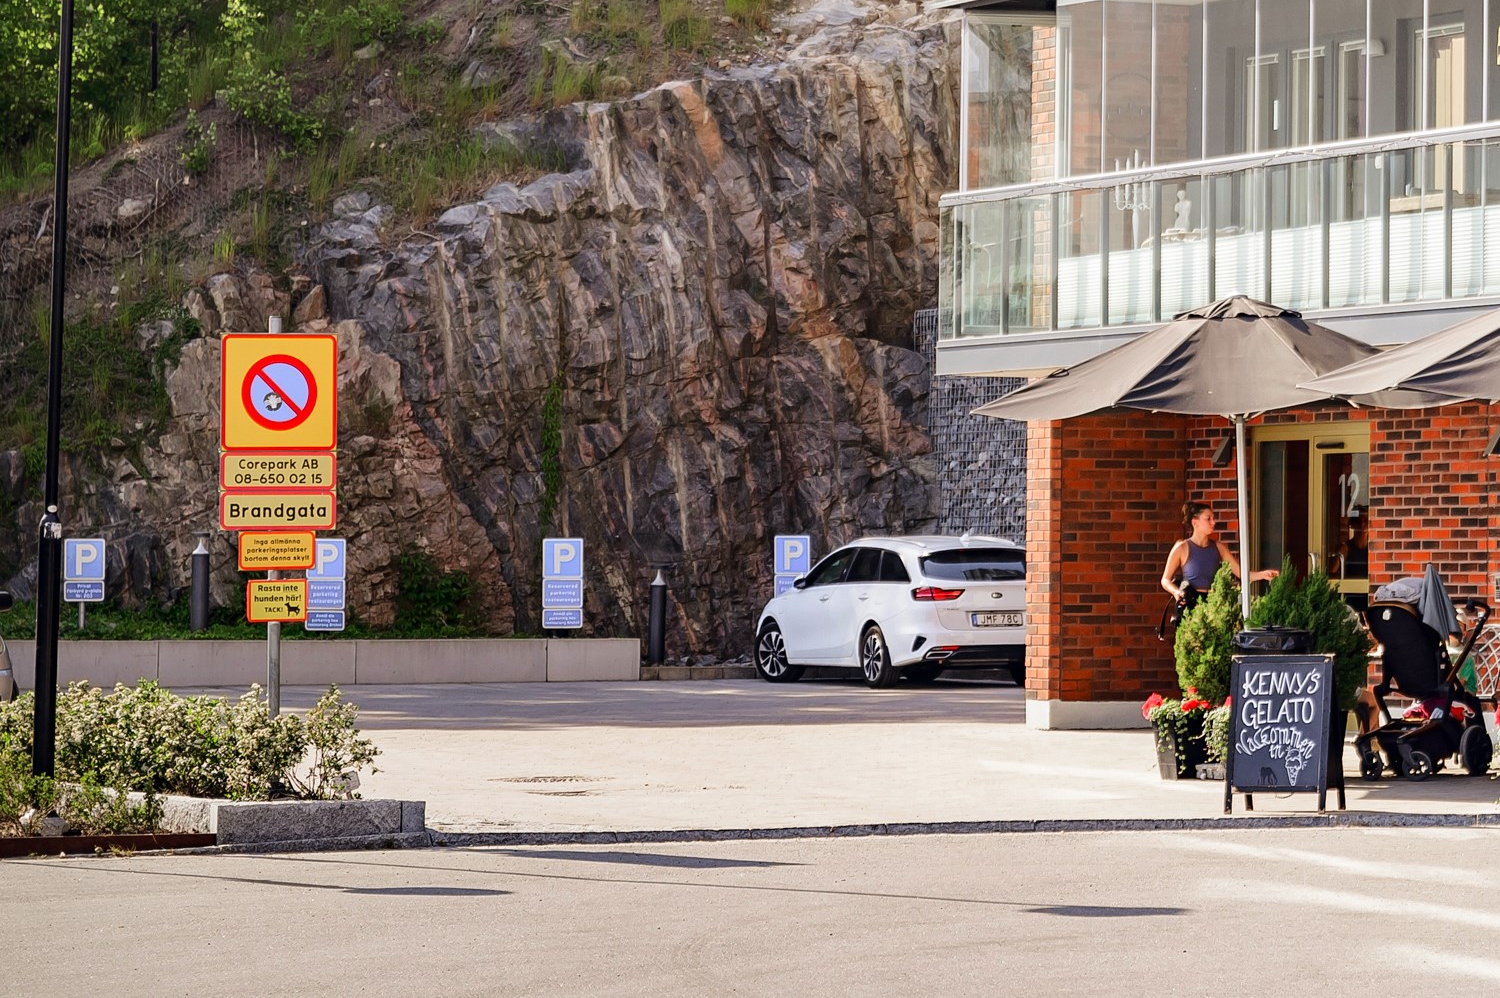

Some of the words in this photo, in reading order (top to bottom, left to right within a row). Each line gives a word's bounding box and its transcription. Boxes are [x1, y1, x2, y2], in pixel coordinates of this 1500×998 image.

[234, 473, 285, 484] 08-650
[289, 473, 306, 484] 02
[311, 473, 322, 484] 15
[238, 459, 297, 472] Corepark
[301, 459, 319, 470] AB
[1338, 473, 1360, 518] 12
[229, 503, 327, 521] Brandgata
[75, 543, 97, 576] P
[317, 543, 339, 575] P
[553, 543, 576, 574] P
[783, 540, 803, 571] P
[286, 594, 302, 602] här!
[981, 615, 998, 624] JMF
[1001, 614, 1019, 624] 78C
[1242, 667, 1321, 699] KENNY'S
[1241, 697, 1314, 730] GELATO
